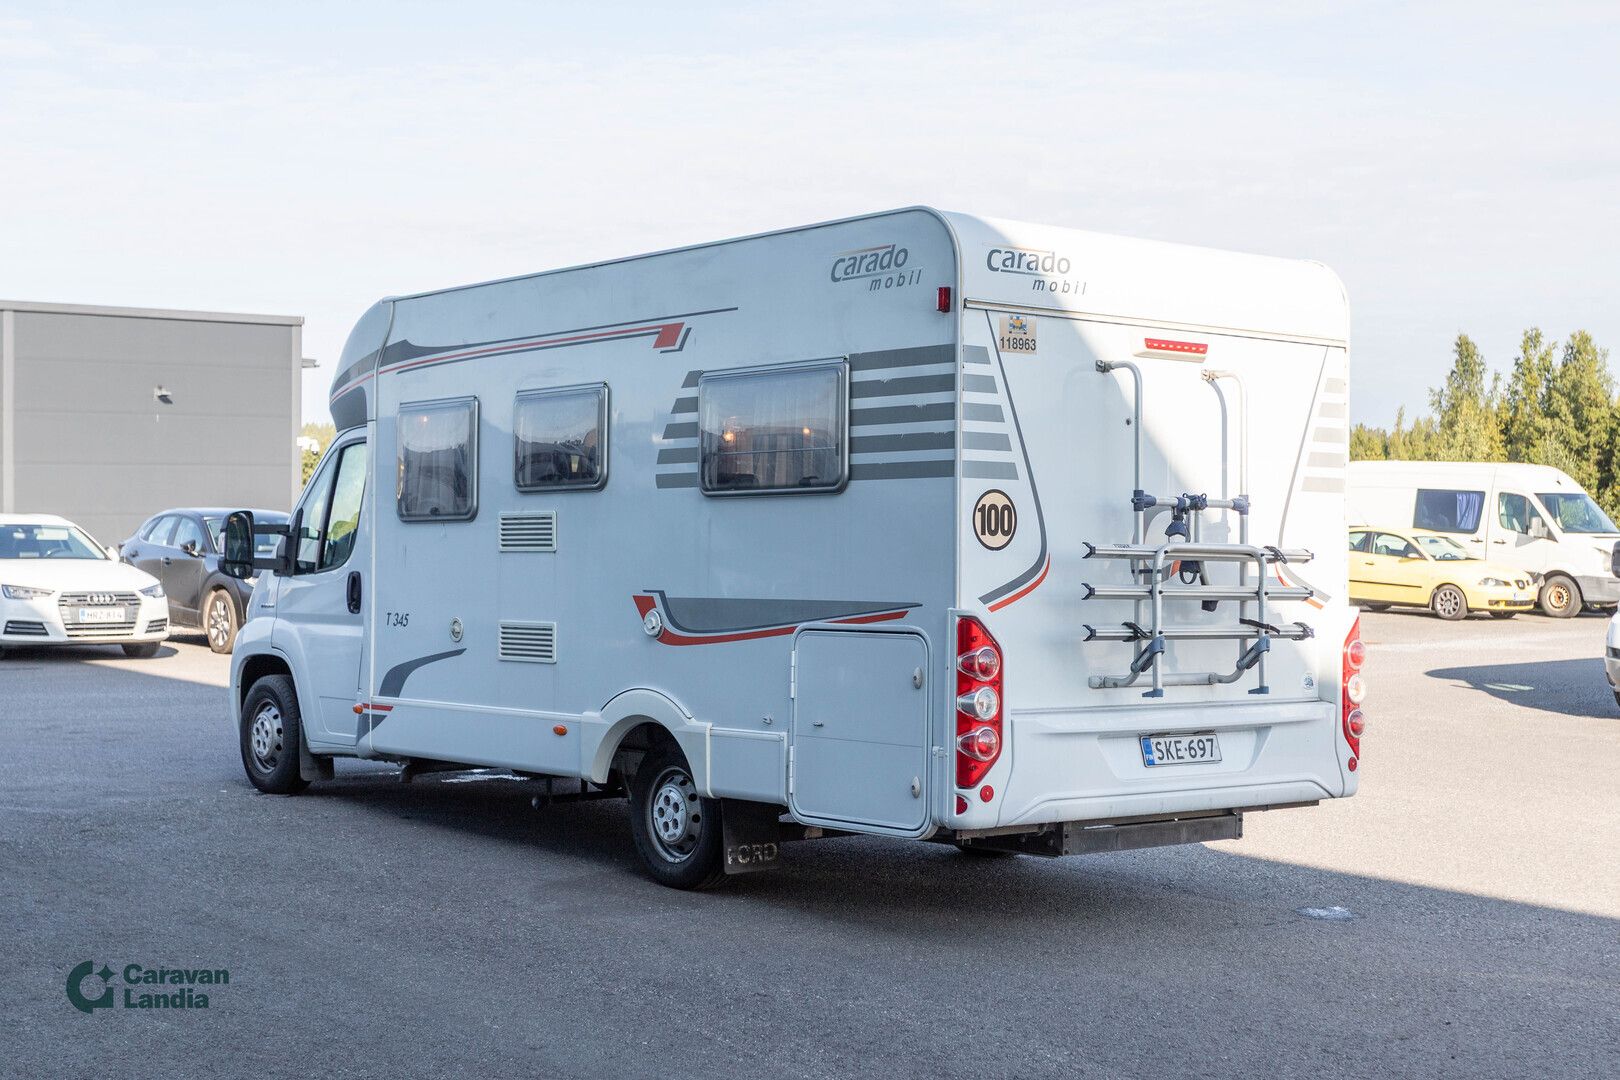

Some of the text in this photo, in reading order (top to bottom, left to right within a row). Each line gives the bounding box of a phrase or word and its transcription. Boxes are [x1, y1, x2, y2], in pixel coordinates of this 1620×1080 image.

[869, 269, 922, 292] mobil
[1032, 279, 1087, 296] mobil
[1000, 336, 1037, 351] 118963
[977, 503, 1013, 537] 100
[386, 612, 410, 627] T 345
[1155, 738, 1214, 760] SKE-697
